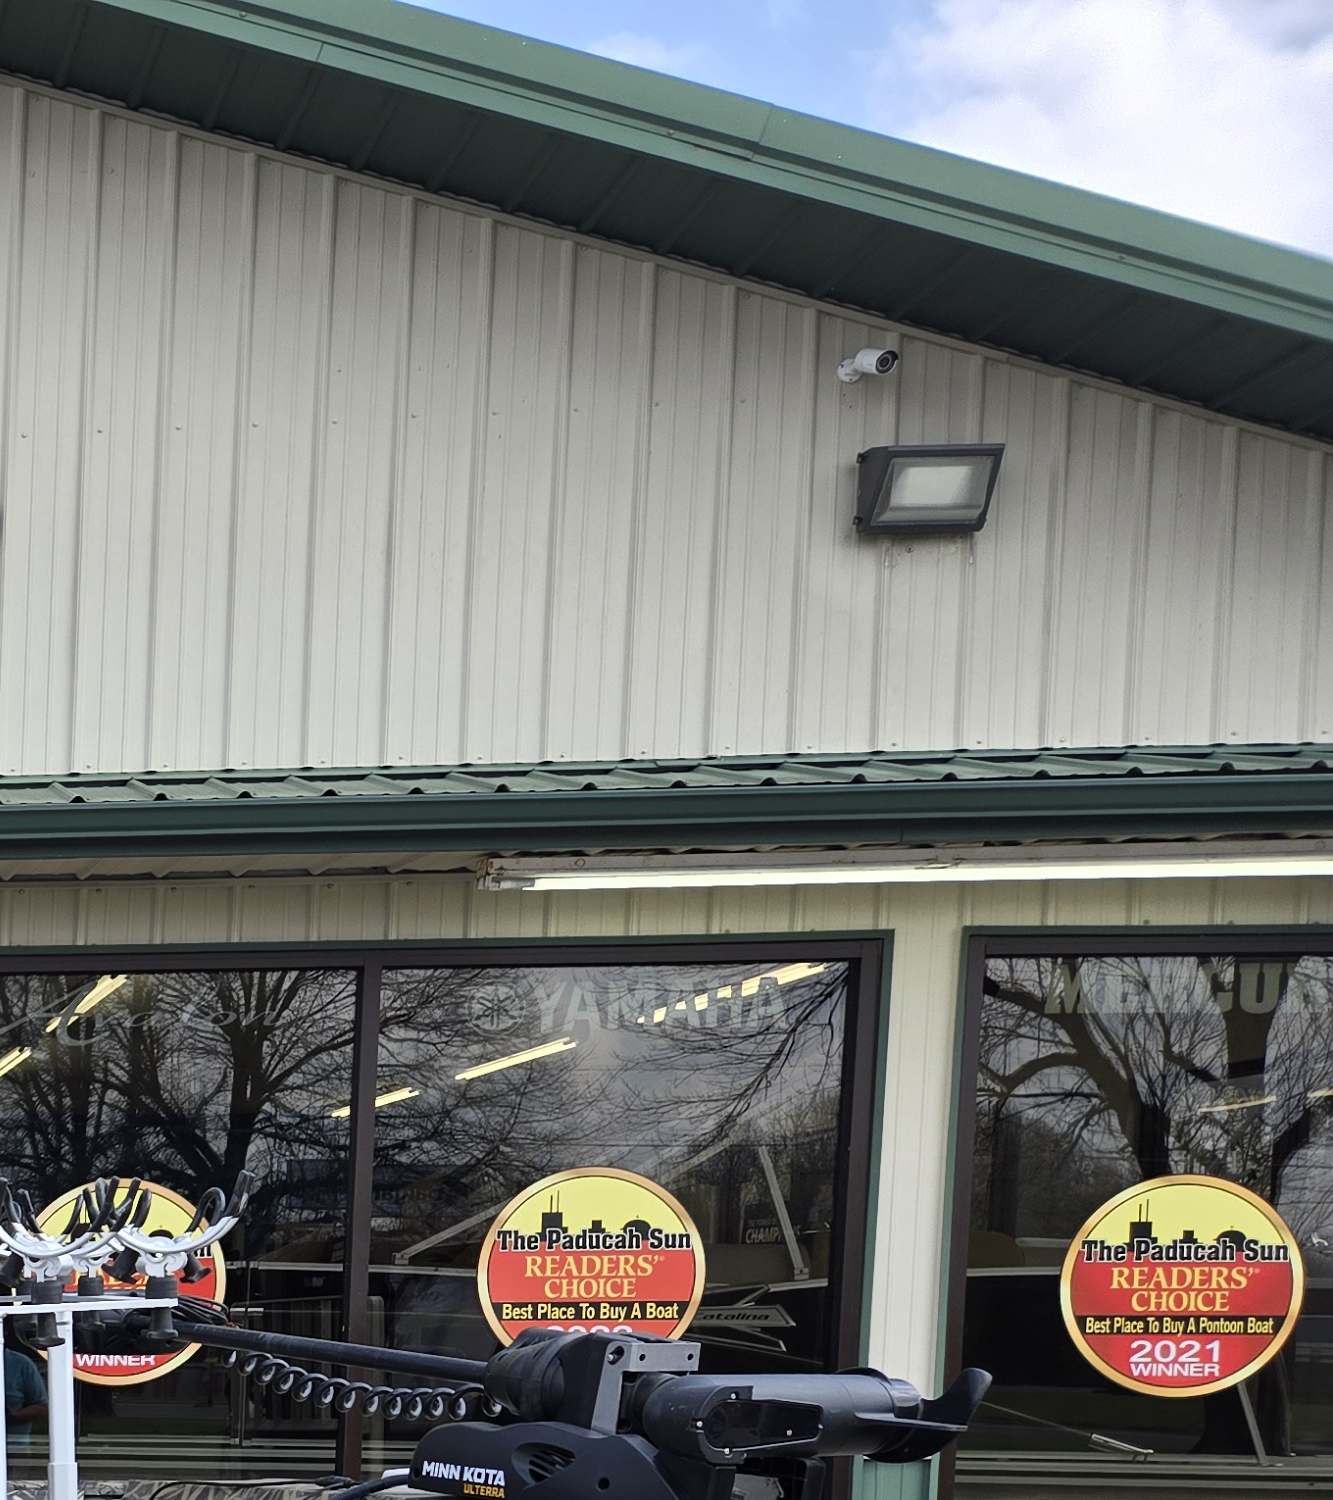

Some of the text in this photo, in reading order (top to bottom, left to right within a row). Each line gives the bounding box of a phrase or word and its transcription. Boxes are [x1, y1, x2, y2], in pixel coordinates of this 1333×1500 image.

[496, 1226, 692, 1252] The Paducah Sun
[1081, 1236, 1290, 1263] The Paducah Sun
[544, 1278, 637, 1299] CHOICE
[1131, 1290, 1230, 1312] CHOICE
[502, 1302, 679, 1322] Best Place To Buy A Boat
[1085, 1316, 1274, 1337] Best Place To Buy A Pontoon Boat
[76, 1354, 156, 1367] WINNER
[1129, 1339, 1221, 1363] 2021
[1130, 1363, 1221, 1377] WINNER
[421, 1460, 506, 1487] MINN KOTA
[463, 1483, 506, 1499] ULTERRA
